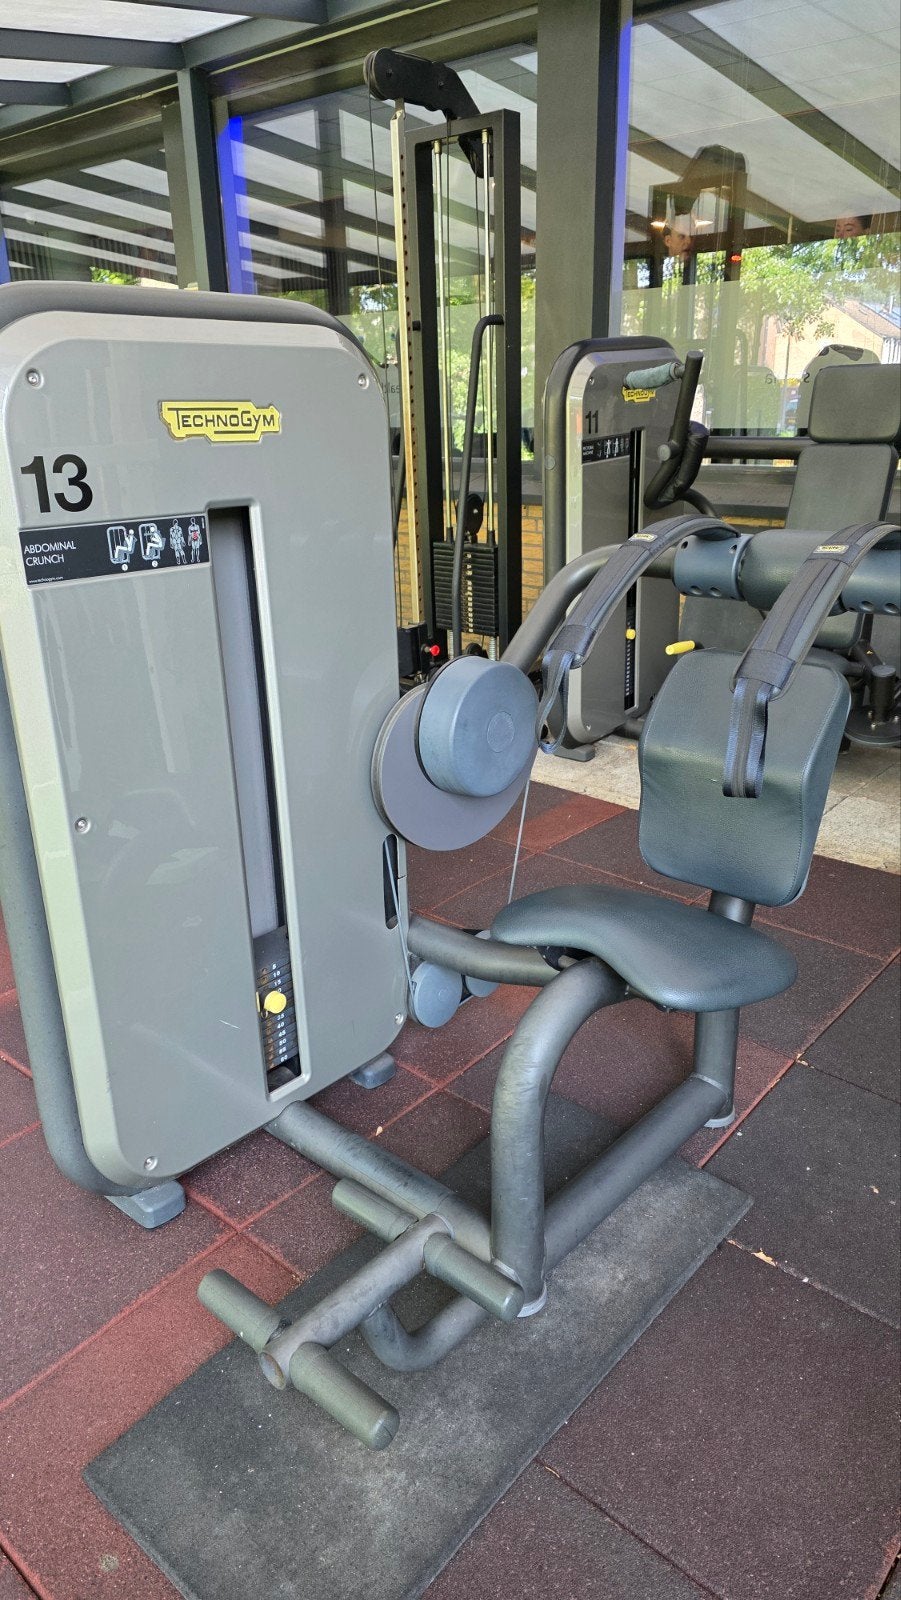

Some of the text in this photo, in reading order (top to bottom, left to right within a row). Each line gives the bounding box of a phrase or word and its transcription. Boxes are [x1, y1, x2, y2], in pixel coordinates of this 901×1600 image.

[167, 407, 275, 435] TECHNOGYM
[585, 410, 599, 434] 11
[20, 454, 94, 514] 13
[24, 541, 77, 555] ABDOMINAL
[25, 554, 65, 567] CRUNCH
[273, 970, 281, 978] 10
[277, 1021, 285, 1029] 40
[278, 1029, 286, 1037] 45
